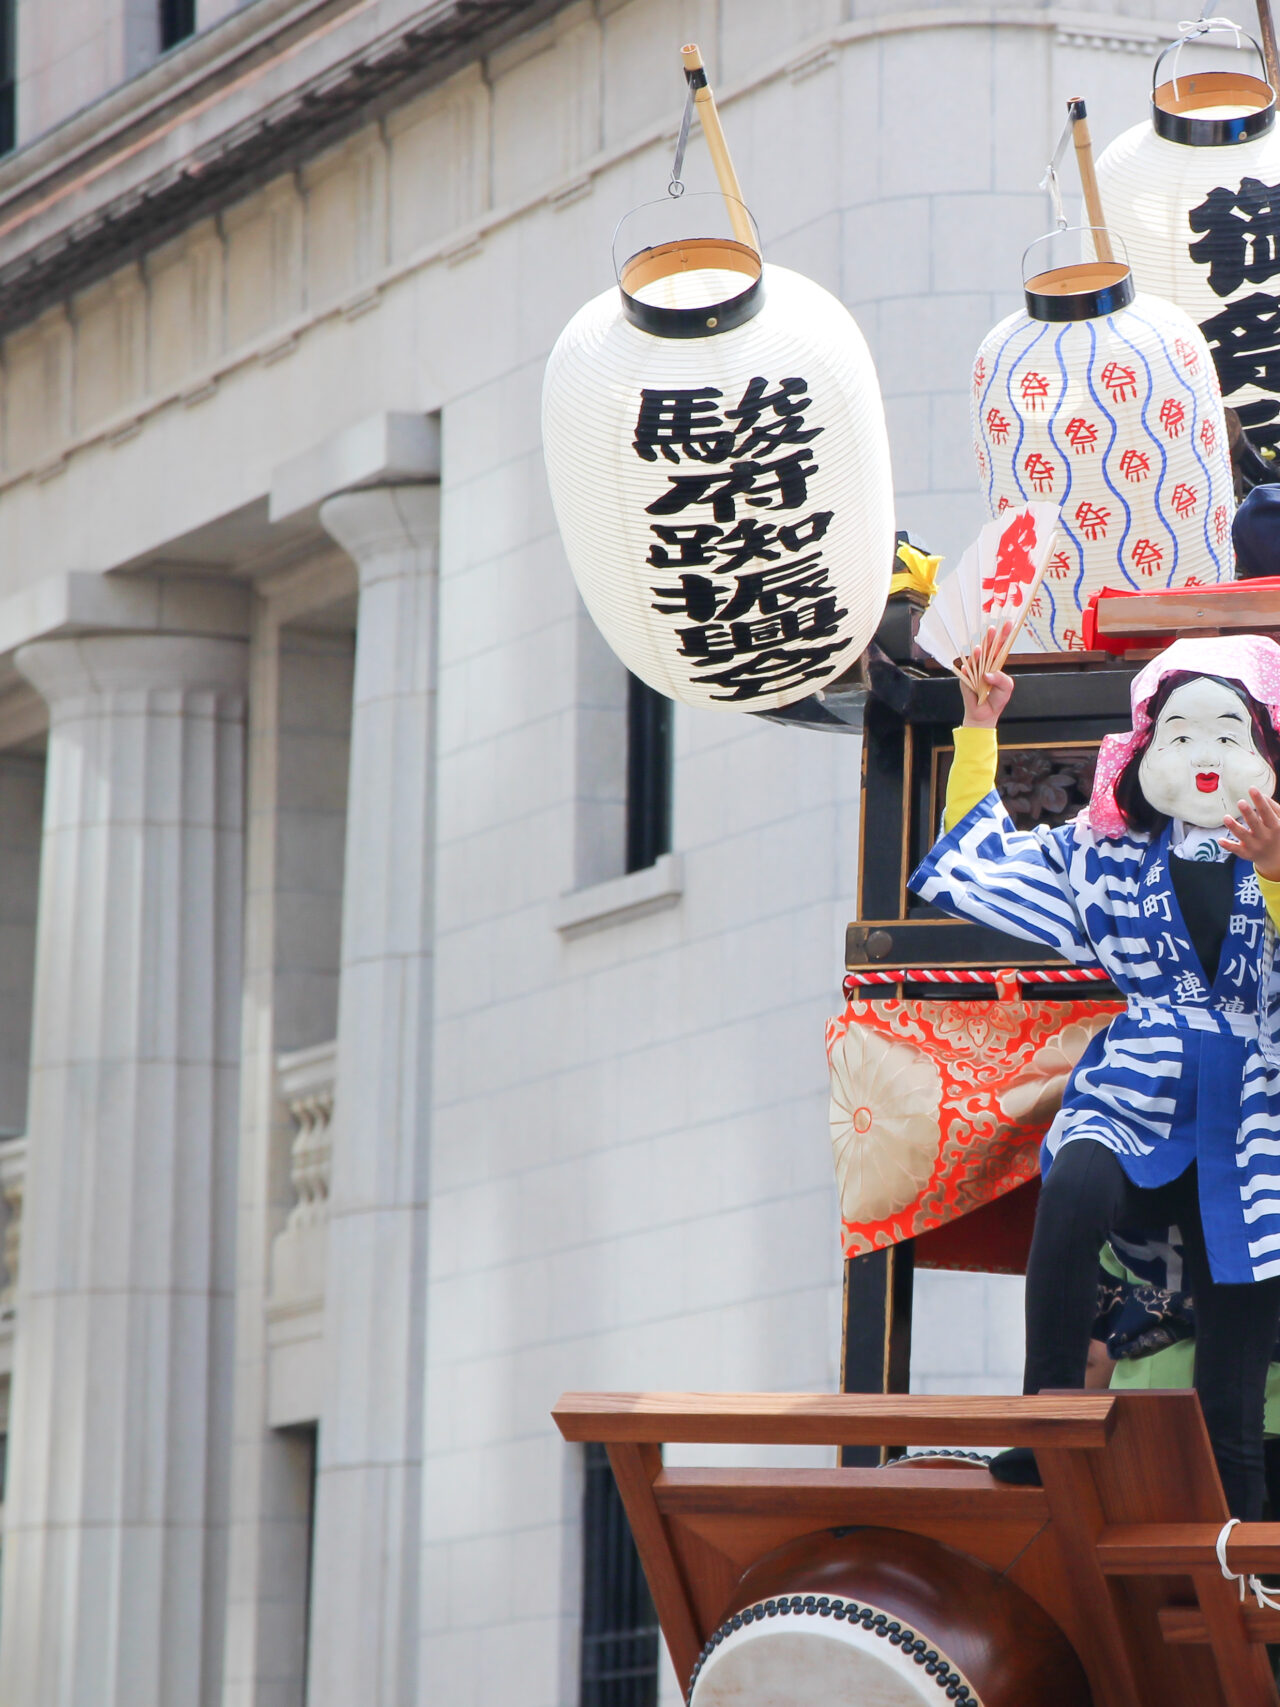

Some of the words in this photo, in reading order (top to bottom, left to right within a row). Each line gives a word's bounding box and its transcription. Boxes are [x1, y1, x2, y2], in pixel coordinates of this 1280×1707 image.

[1021, 372, 1050, 410] 祭
[1101, 362, 1136, 403] 祭
[987, 408, 1011, 444] 祭
[1065, 418, 1098, 455] 祭
[1160, 399, 1184, 438] 祭
[1024, 453, 1055, 493] 祭
[1120, 450, 1150, 482] 祭
[1171, 483, 1197, 519] 祭
[1075, 502, 1111, 541] 祭
[1131, 539, 1163, 576] 祭
[1142, 858, 1210, 1005] 番町小連
